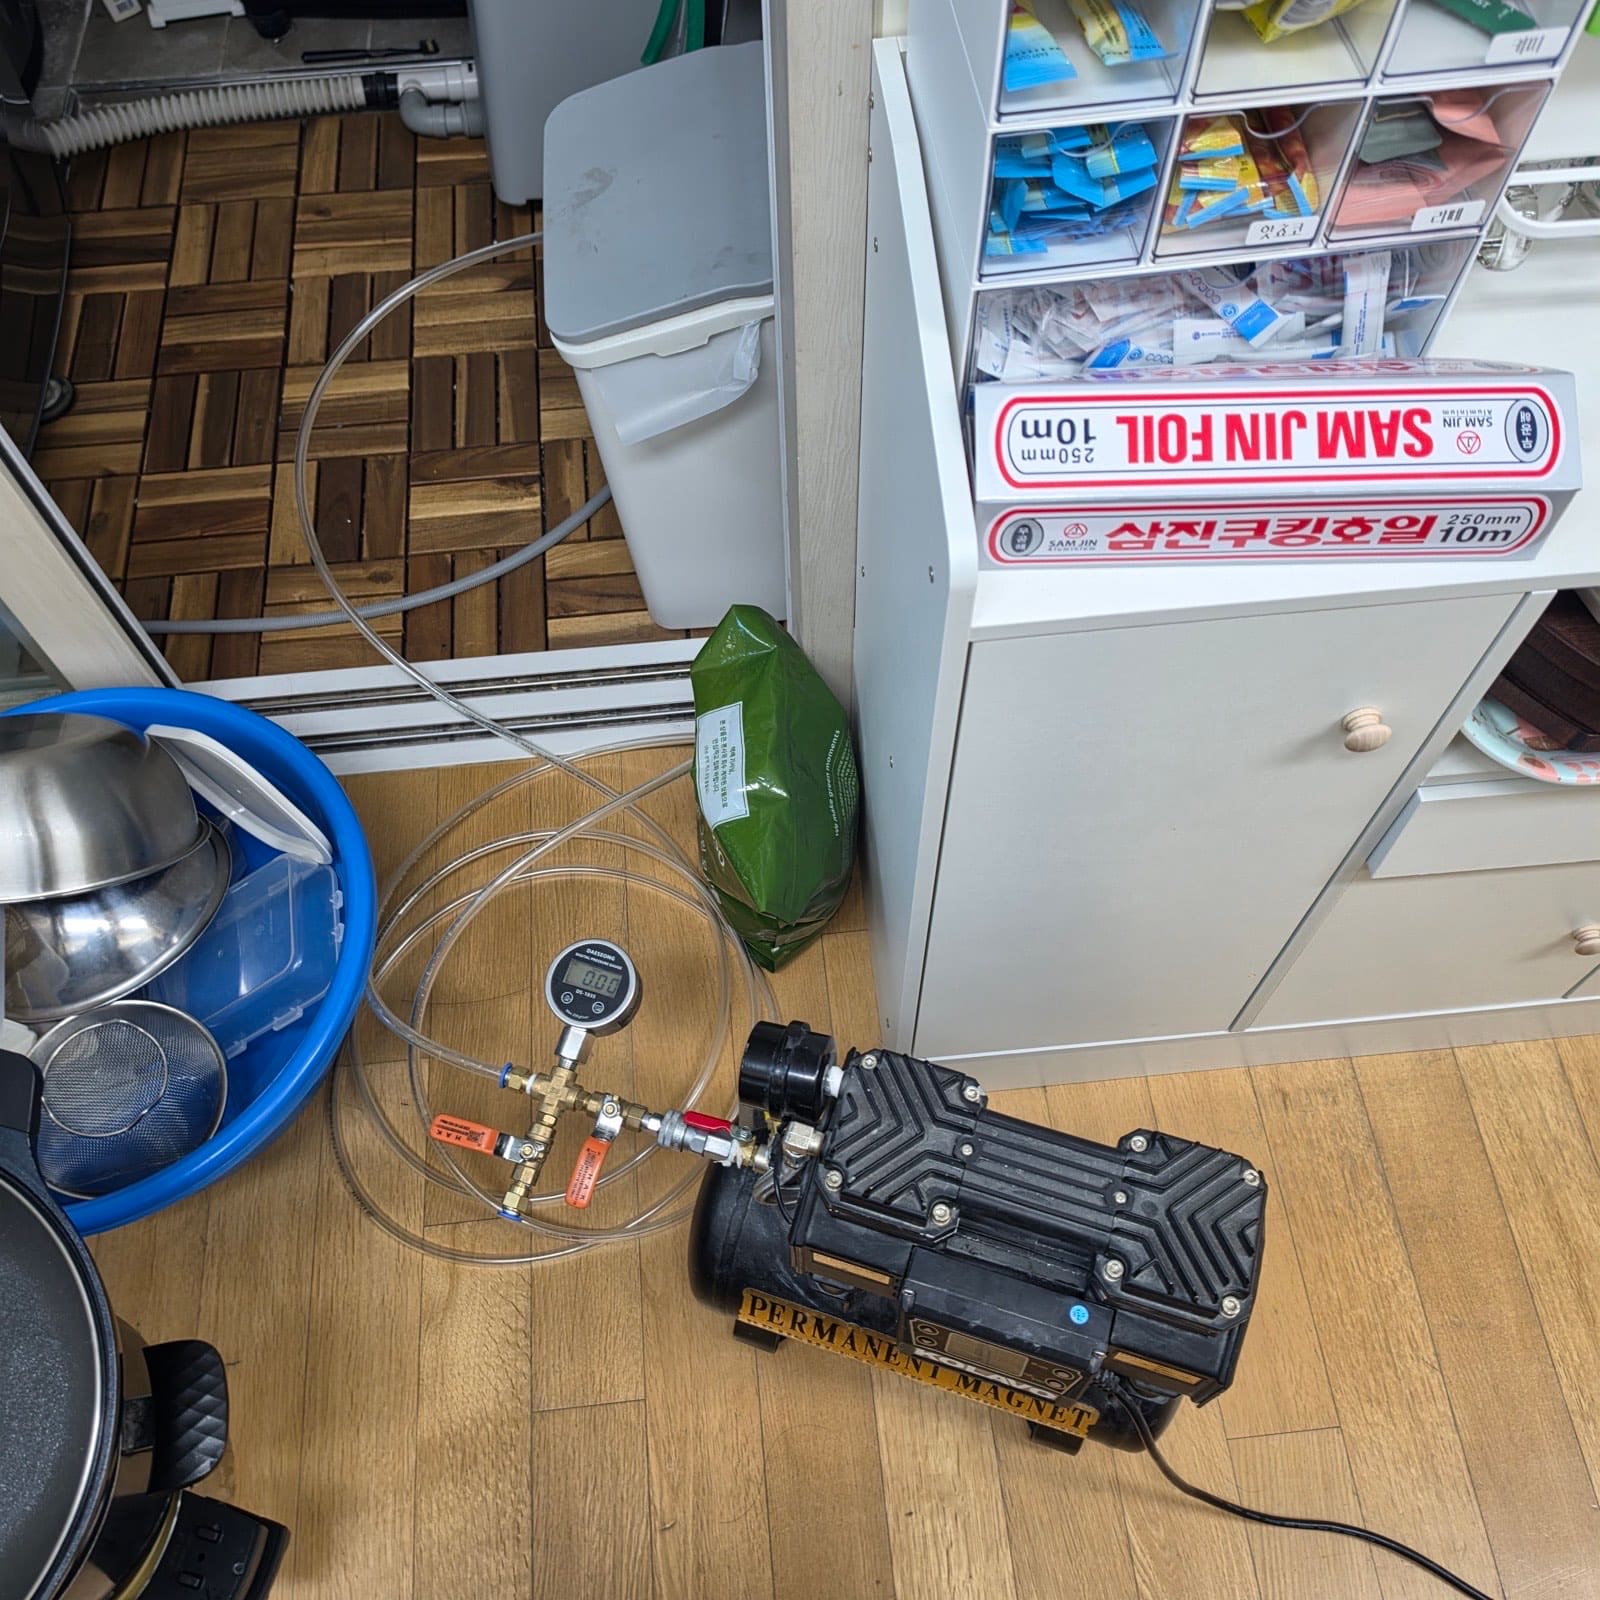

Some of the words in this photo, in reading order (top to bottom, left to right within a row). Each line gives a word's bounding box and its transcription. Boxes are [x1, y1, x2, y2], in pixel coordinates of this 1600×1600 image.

[1020, 418, 1097, 446] 10m
[1226, 412, 1307, 461] JIN
[1317, 408, 1434, 460] SAM
[1442, 418, 1462, 428] JIN
[1464, 417, 1493, 428] SAM
[1020, 447, 1096, 463] 250mm
[1115, 413, 1212, 465] FOIL
[1104, 514, 1439, 550] 삼진쿠킹호일
[1440, 526, 1512, 543] 10m
[1447, 514, 1521, 524] 250mm
[1076, 539, 1098, 547] JIN
[826, 730, 841, 771] moments
[914, 1348, 1060, 1400] KOLAVO
[955, 1371, 1093, 1431] MAGNET
